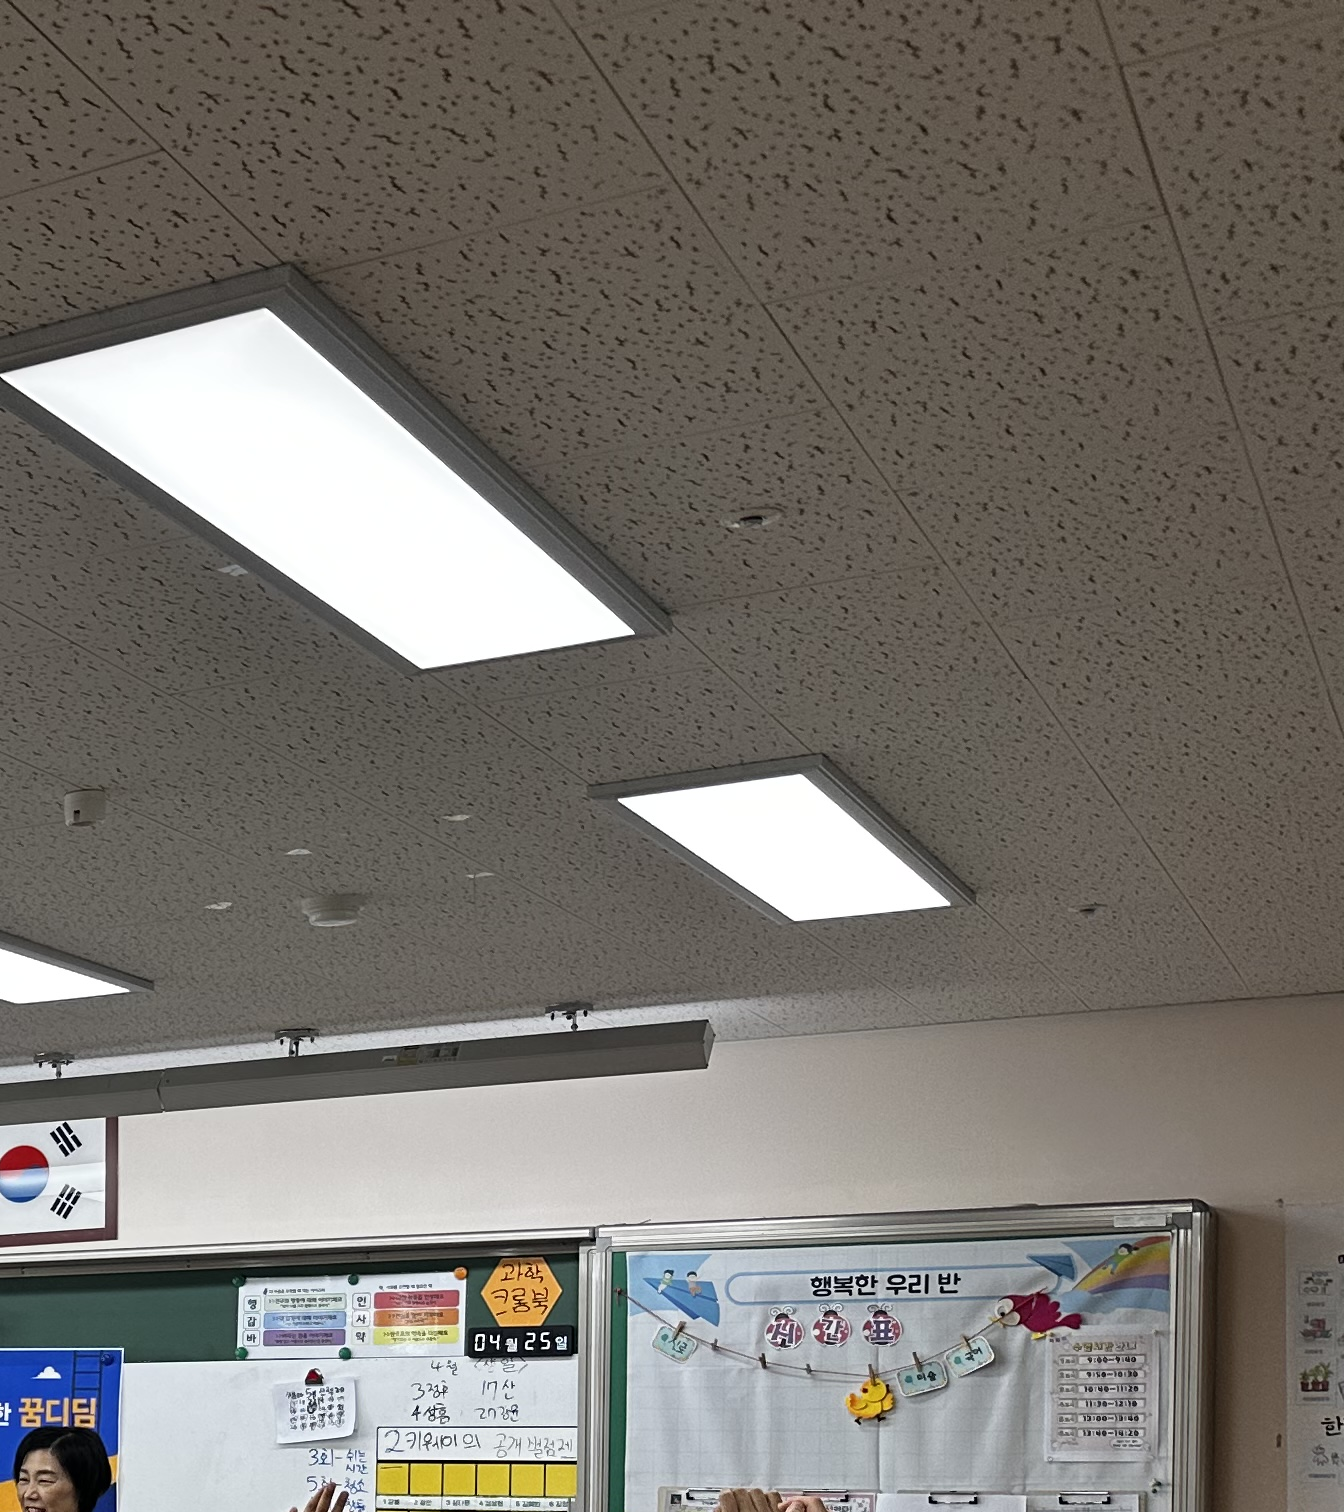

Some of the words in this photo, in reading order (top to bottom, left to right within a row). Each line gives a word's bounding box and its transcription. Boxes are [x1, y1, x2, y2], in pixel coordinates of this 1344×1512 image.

[500, 1262, 544, 1284] 과학
[810, 1274, 879, 1297] 행복한
[886, 1274, 929, 1296] 우리
[938, 1273, 961, 1295] 반
[357, 1296, 367, 1308] 인
[356, 1314, 367, 1324] 사
[869, 1319, 895, 1342] 표
[18, 1397, 98, 1428] 꿈디딤
[346, 1449, 368, 1463] 쉬는
[493, 1433, 522, 1458] 공개
[346, 1463, 368, 1475] 시간
